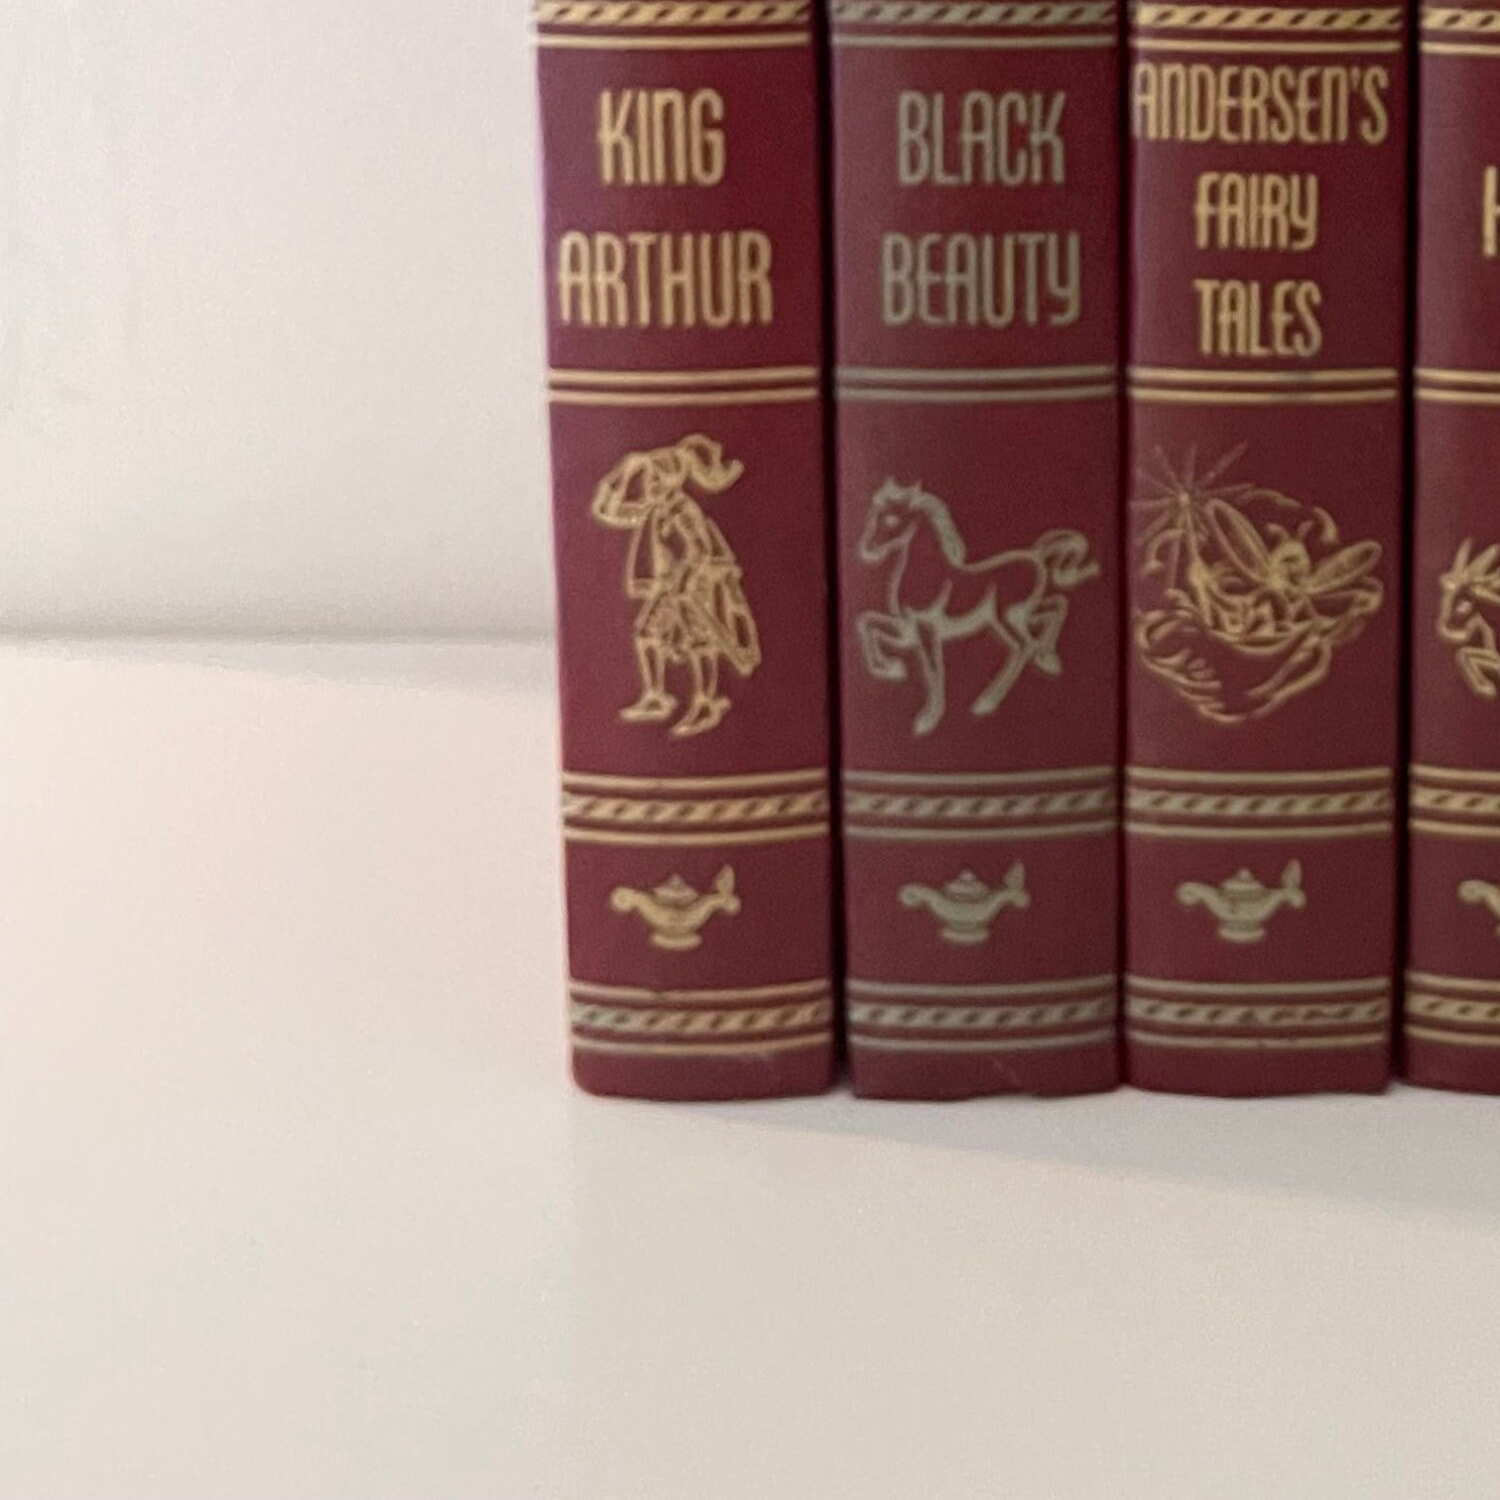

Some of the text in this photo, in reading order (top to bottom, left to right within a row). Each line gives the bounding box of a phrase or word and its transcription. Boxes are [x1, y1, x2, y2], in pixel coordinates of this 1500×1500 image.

[597, 88, 726, 186] KING
[899, 90, 1067, 186] BLACK
[1132, 61, 1389, 145] ANDERSEN'S
[1193, 171, 1319, 251] FAIRY
[558, 230, 774, 327] ARTHUR
[880, 231, 1082, 327] BEAUTY
[1193, 279, 1323, 357] TALES
